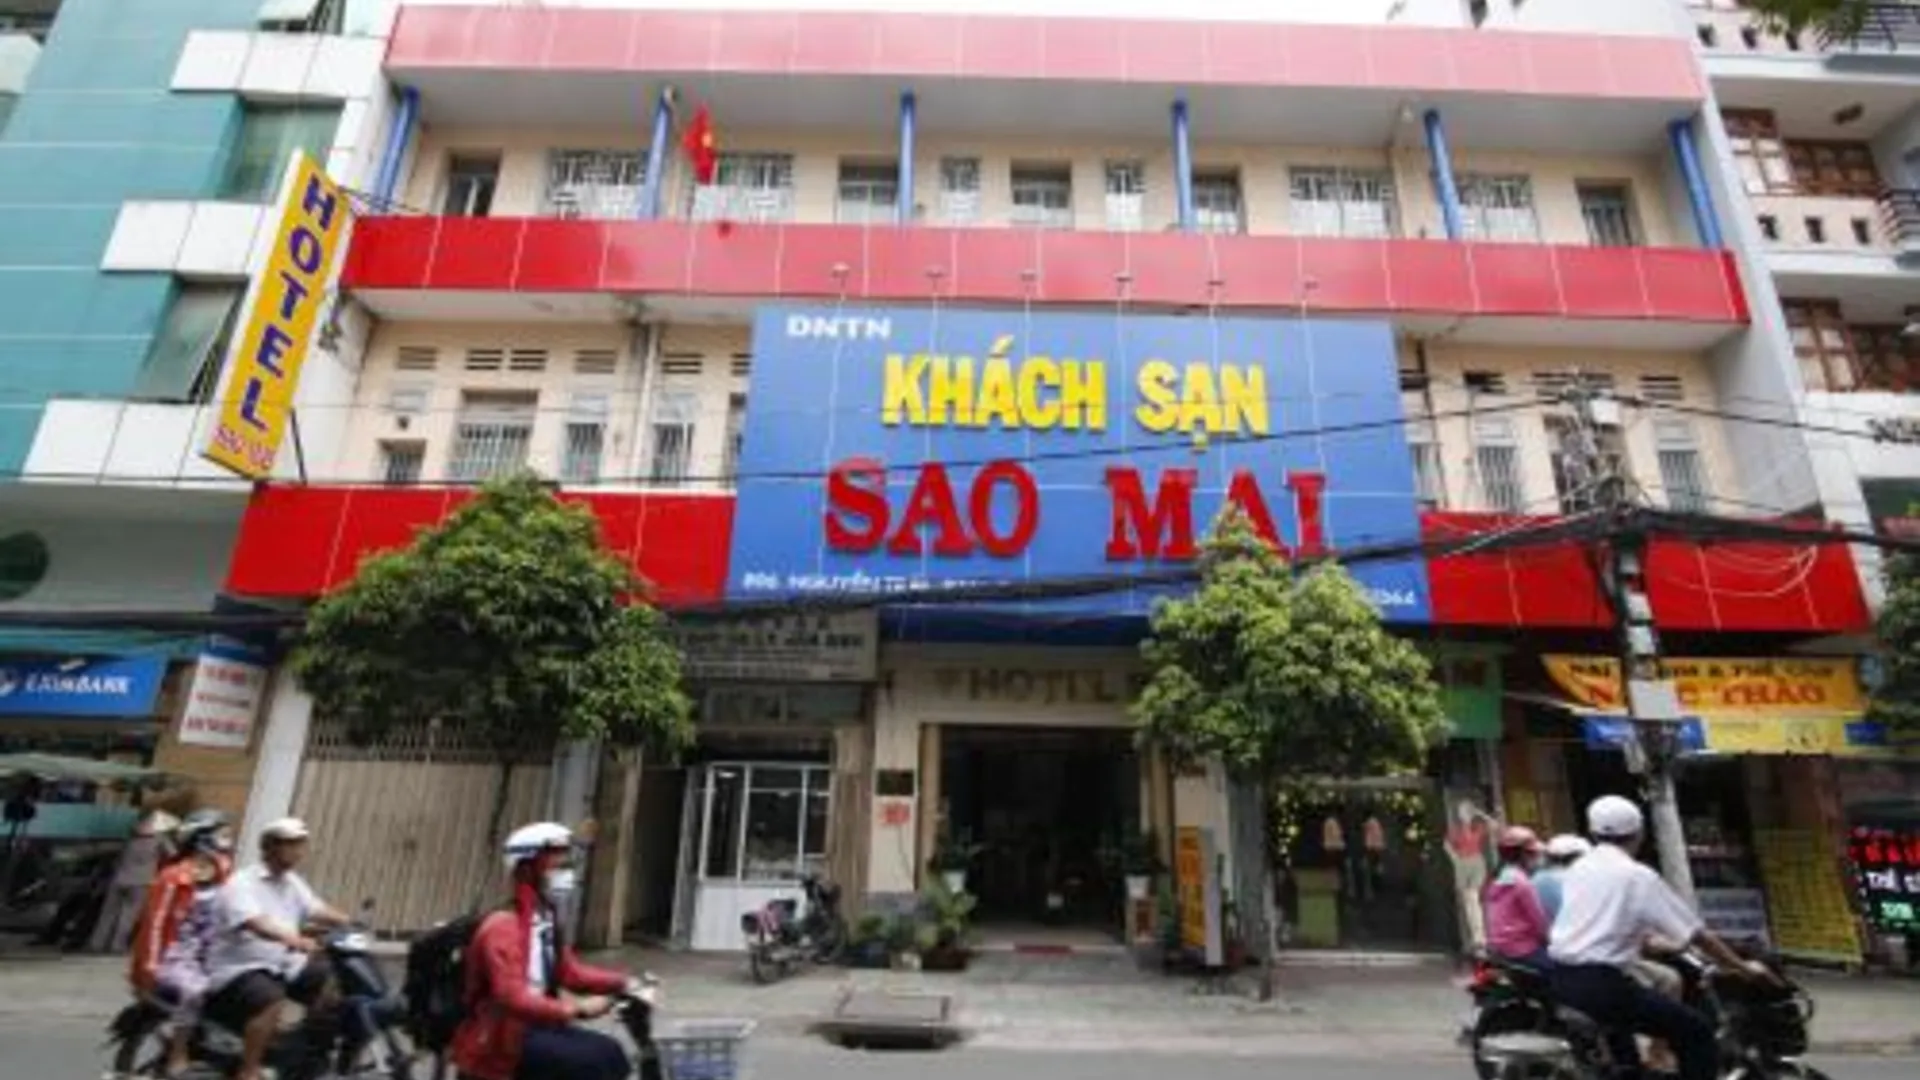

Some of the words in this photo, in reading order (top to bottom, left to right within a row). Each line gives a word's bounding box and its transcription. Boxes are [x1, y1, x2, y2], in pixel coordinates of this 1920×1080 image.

[240, 172, 337, 432] HOTEL
[786, 315, 892, 341] DNTN
[881, 336, 1106, 431] KHÁCH
[1135, 361, 1270, 453] SẠN
[823, 457, 1040, 558] SAO
[1105, 465, 1332, 562] MAI
